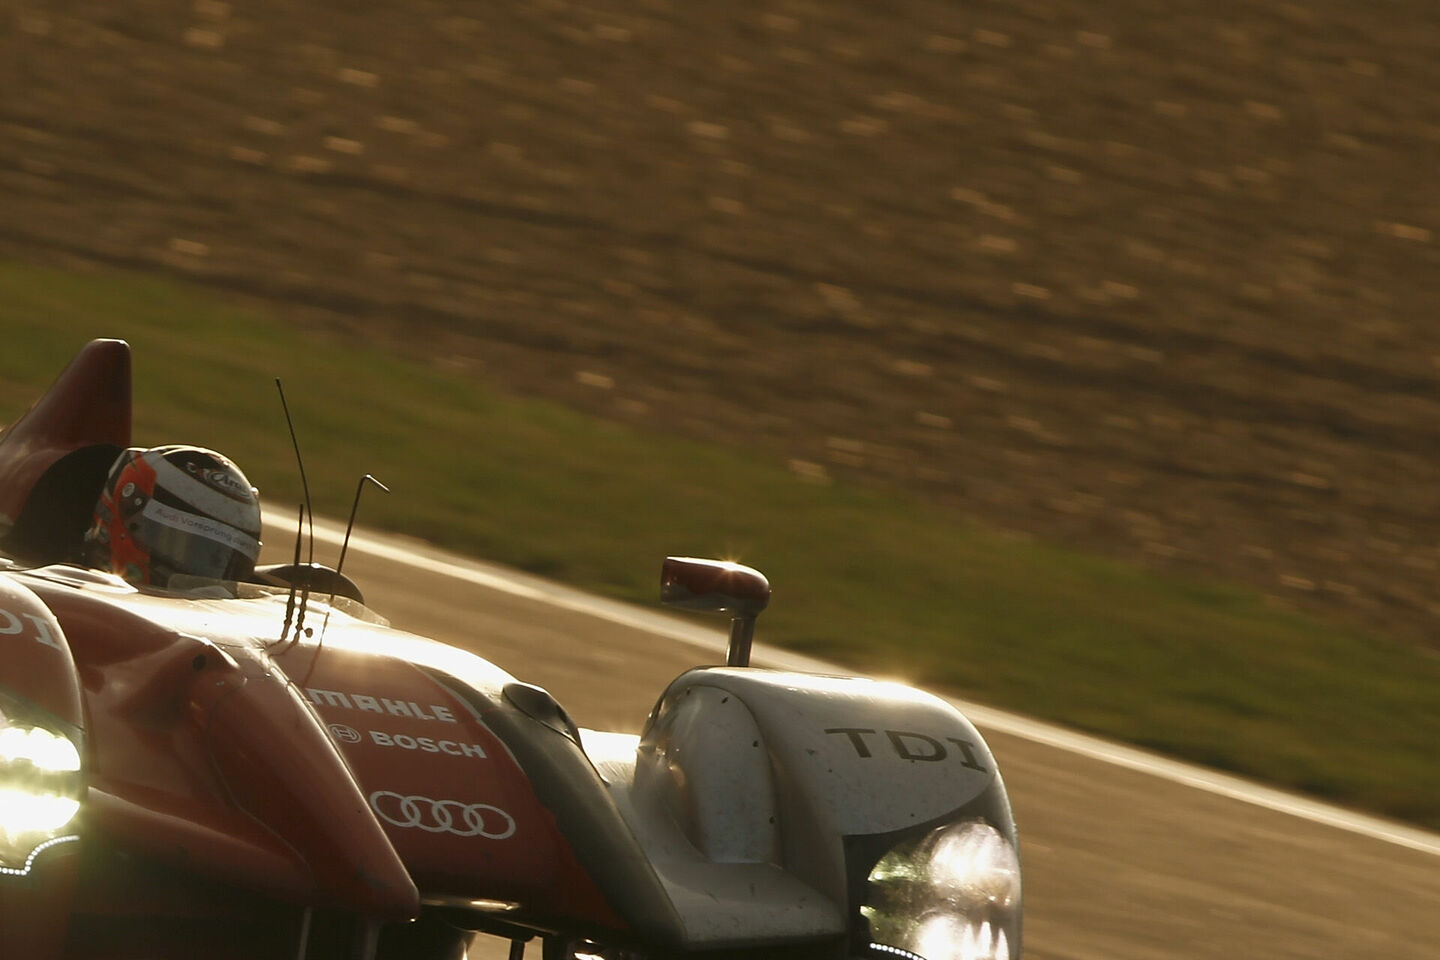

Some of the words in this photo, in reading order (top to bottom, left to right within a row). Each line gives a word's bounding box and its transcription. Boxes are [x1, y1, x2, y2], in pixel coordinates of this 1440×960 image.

[154, 508, 179, 524] Audi
[305, 687, 458, 723] MAHLE
[367, 730, 488, 759] BOSCH
[824, 727, 988, 774] TDI
